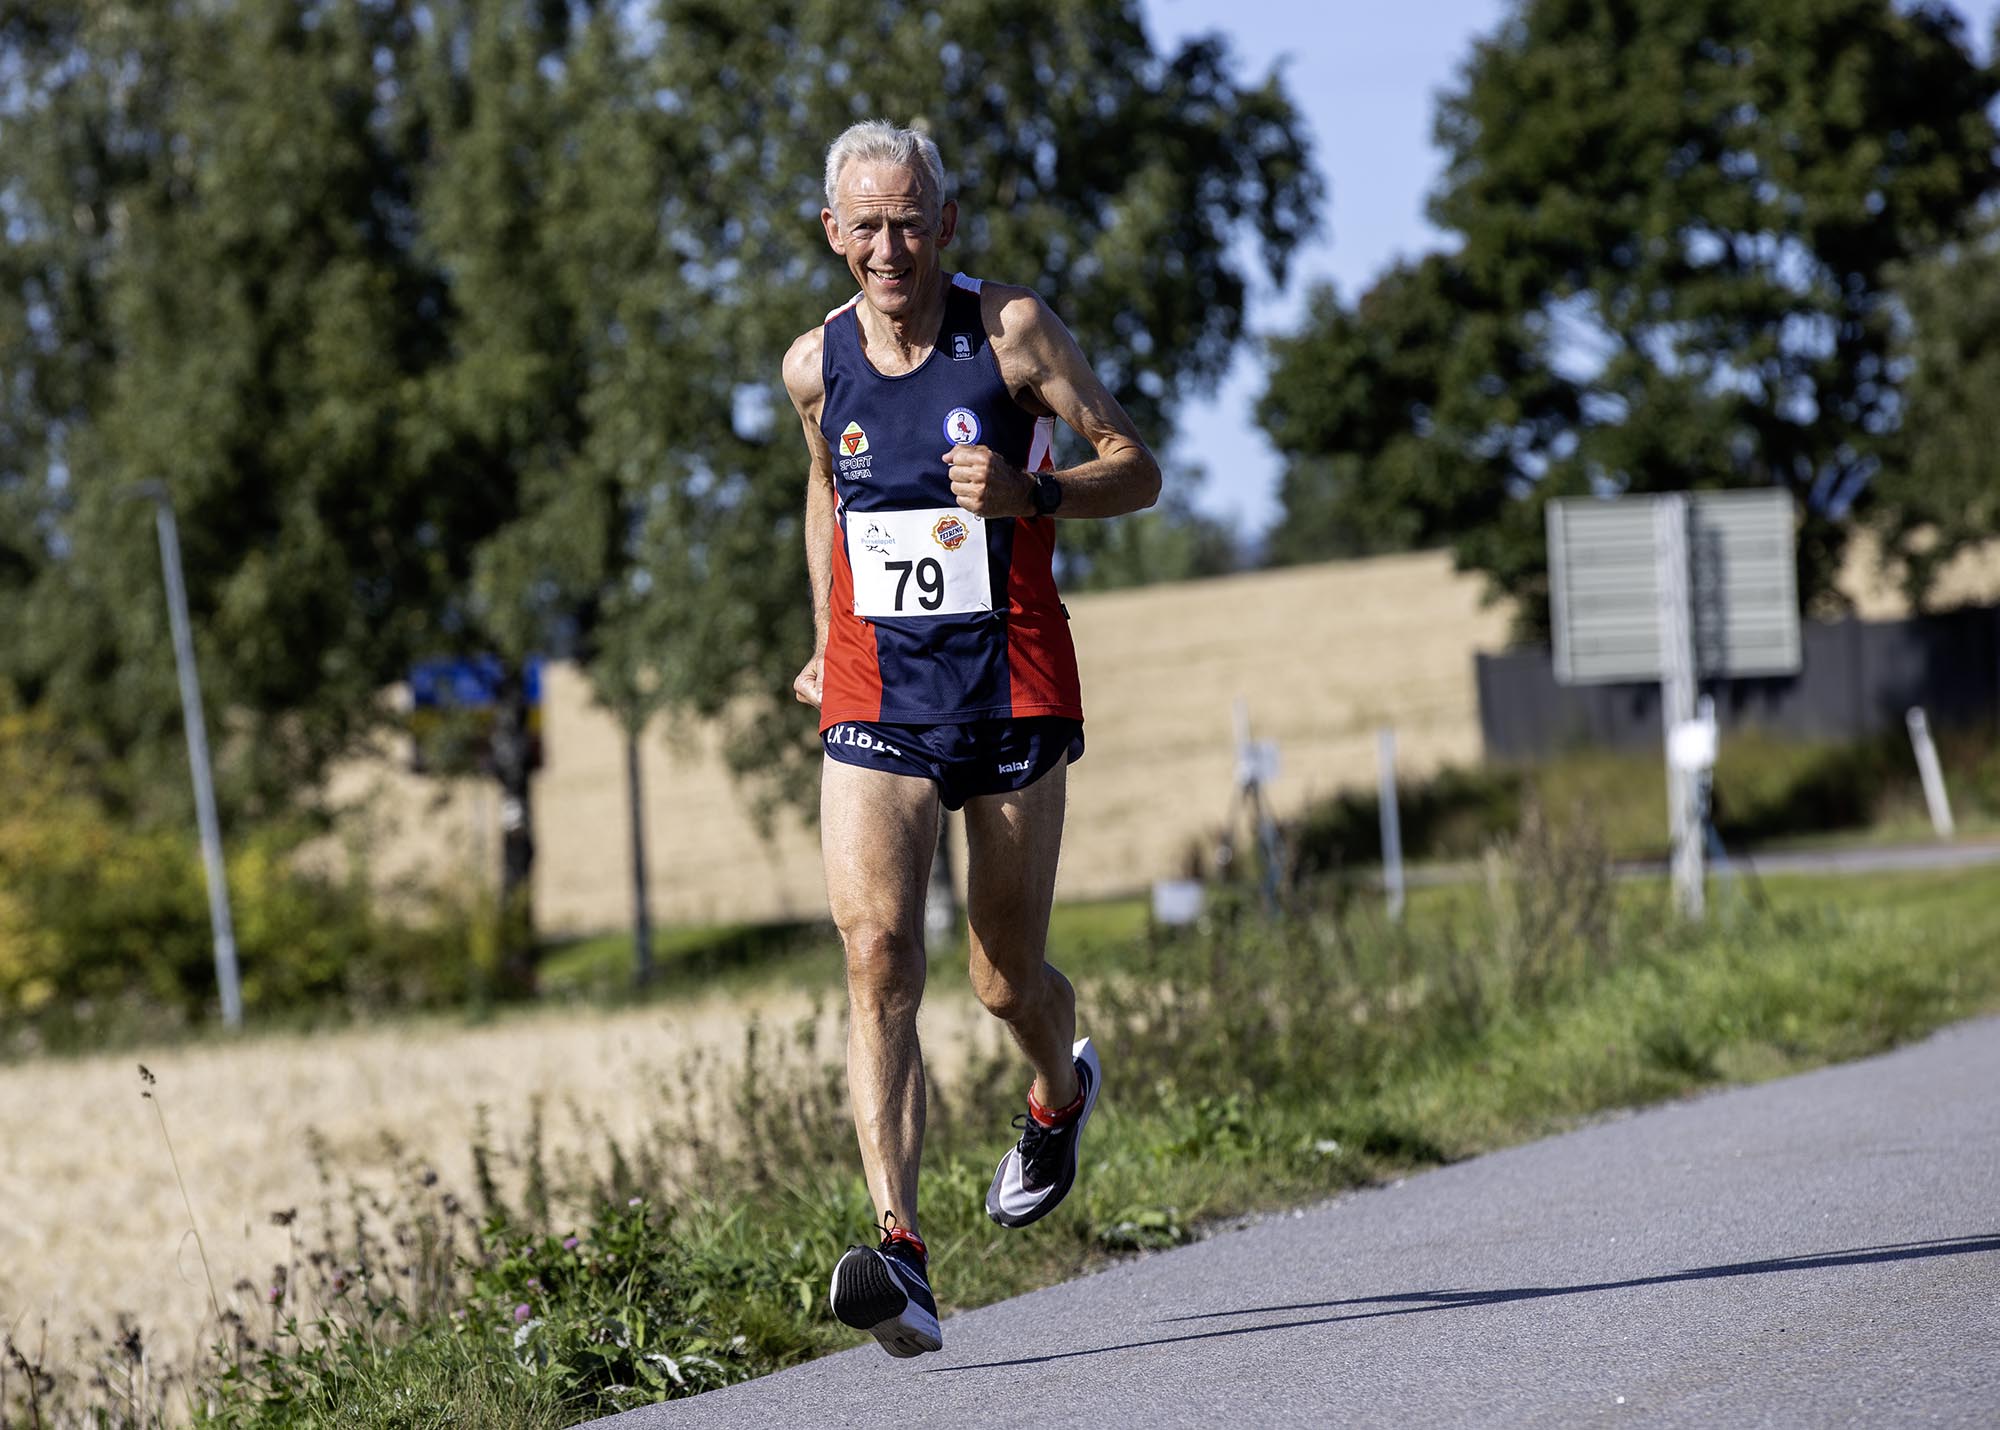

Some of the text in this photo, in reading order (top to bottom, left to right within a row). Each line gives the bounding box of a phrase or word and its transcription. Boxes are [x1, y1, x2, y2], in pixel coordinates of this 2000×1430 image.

[839, 455, 873, 471] SPORT
[884, 557, 945, 611] 79
[998, 759, 1030, 774] kalas
